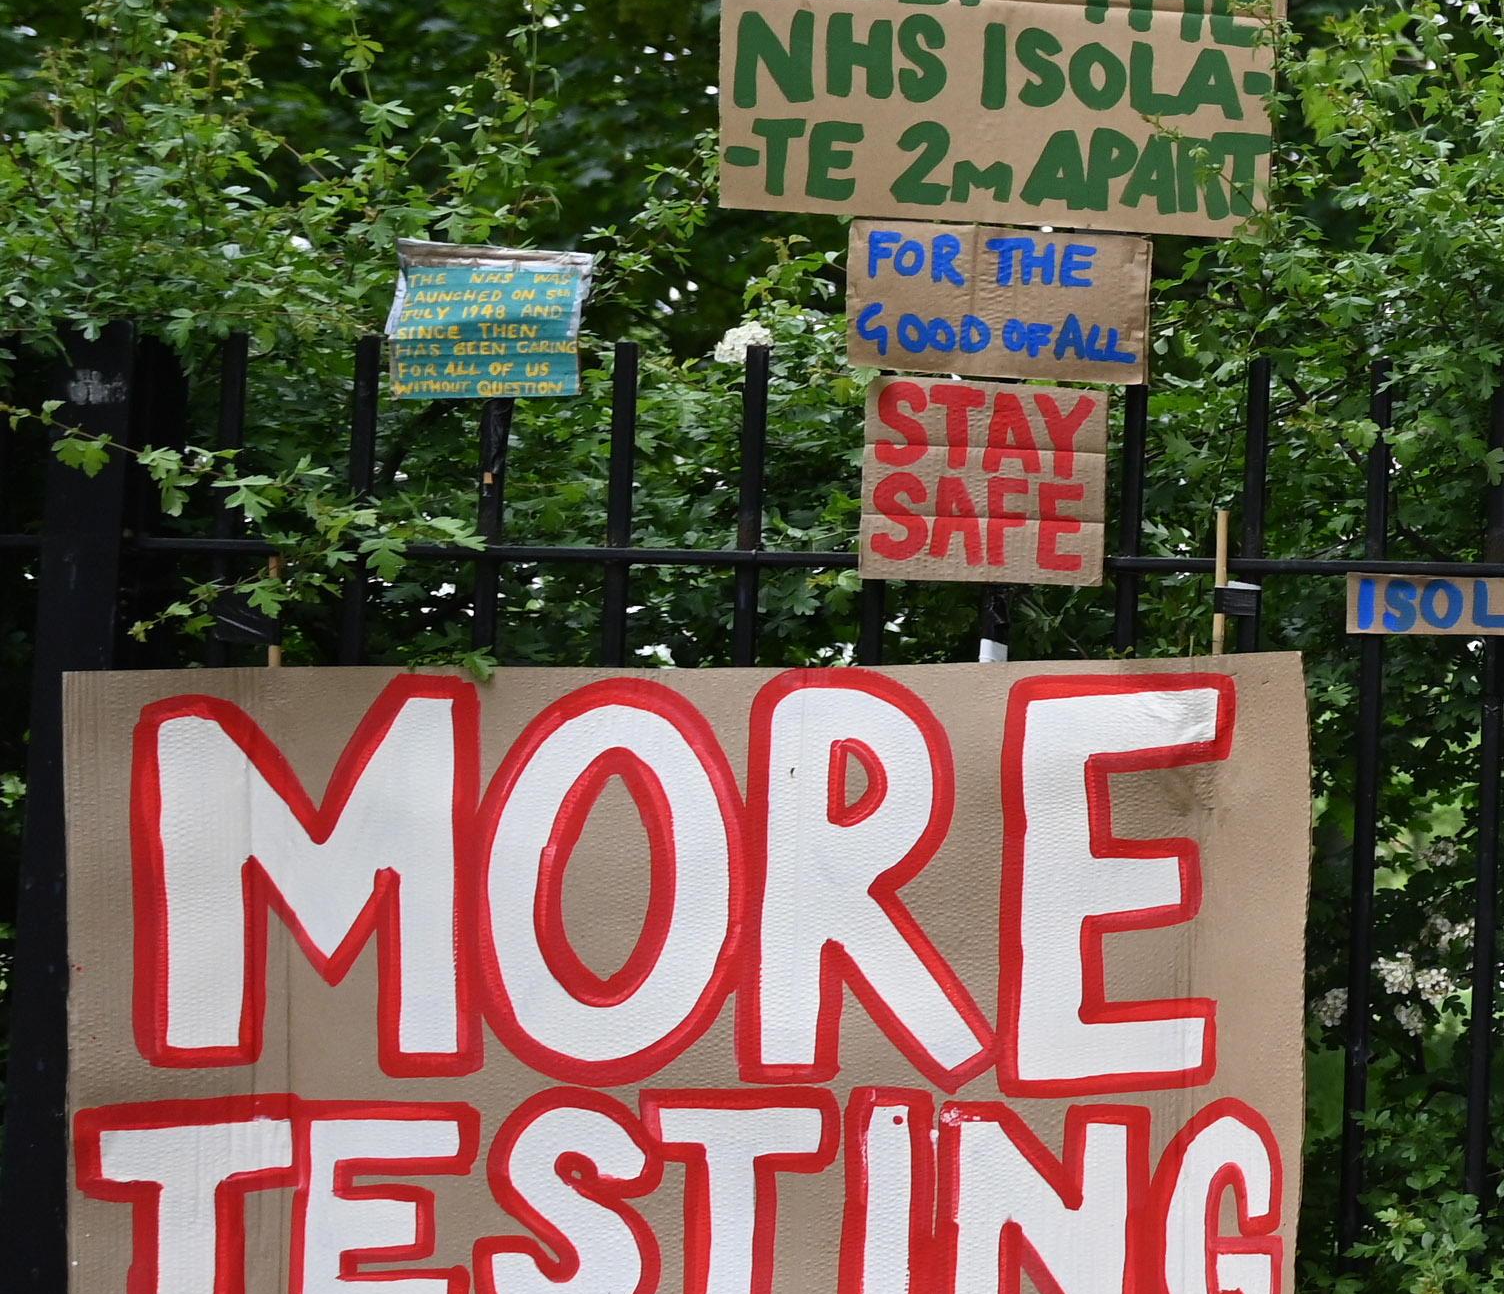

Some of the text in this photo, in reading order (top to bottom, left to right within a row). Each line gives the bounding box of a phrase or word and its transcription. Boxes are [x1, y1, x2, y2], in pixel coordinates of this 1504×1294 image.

[732, 9, 948, 109] NHS
[868, 231, 1097, 287] FOR THE
[469, 273, 572, 284] NHS WAS
[404, 289, 536, 307] LAUNCHED ON
[401, 305, 563, 322] JULY 1948 AND
[478, 323, 539, 339] THEN
[856, 302, 1137, 363] GOOD OF ALL
[453, 341, 577, 356] BEEN CARING
[398, 361, 551, 378] FOR ALL US
[395, 381, 563, 396] WITHOUT QUESTION
[874, 381, 1096, 479] STAY
[870, 471, 1084, 571] SAFE
[130, 666, 1237, 1096] MORE
